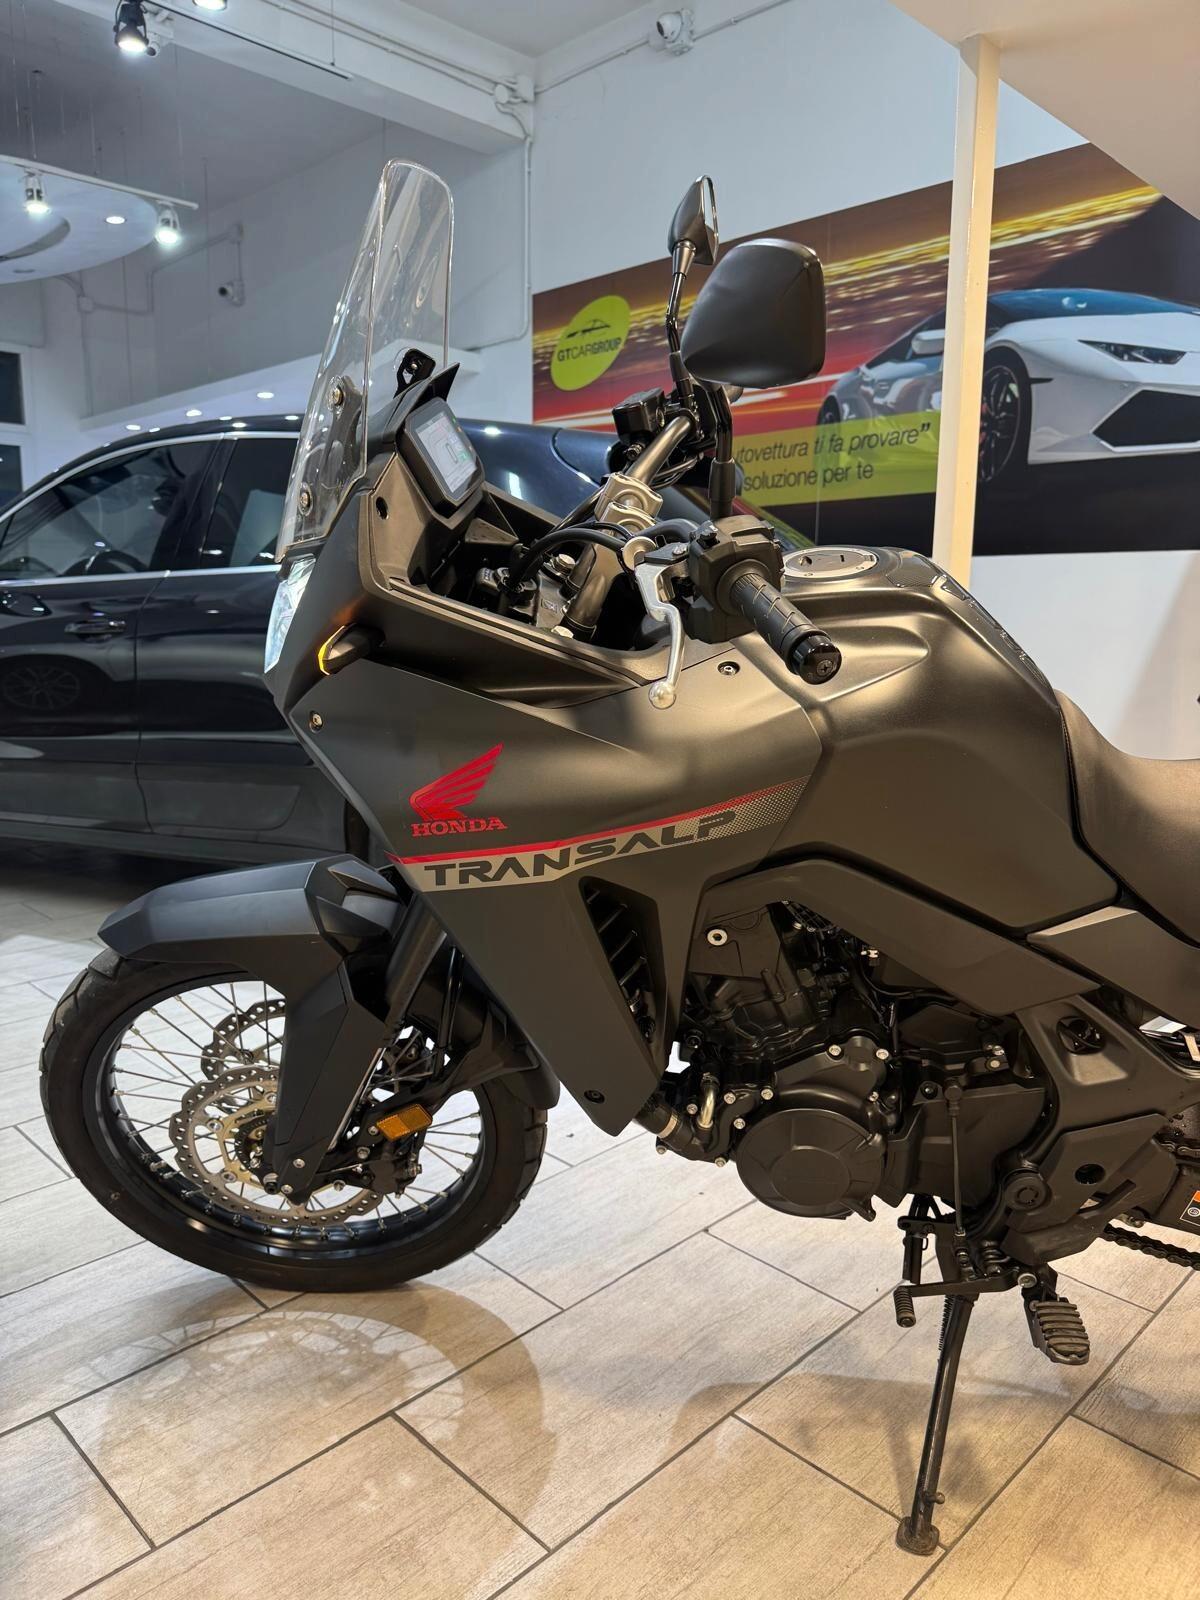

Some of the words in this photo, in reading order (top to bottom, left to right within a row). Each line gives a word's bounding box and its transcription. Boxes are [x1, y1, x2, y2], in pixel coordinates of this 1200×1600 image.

[813, 434, 825, 455] ti
[828, 432, 844, 454] fa
[743, 469, 817, 491] soluzione
[821, 466, 850, 487] per
[856, 463, 874, 480] te
[411, 817, 508, 837] HONDA
[424, 810, 736, 887] TRANSALP
